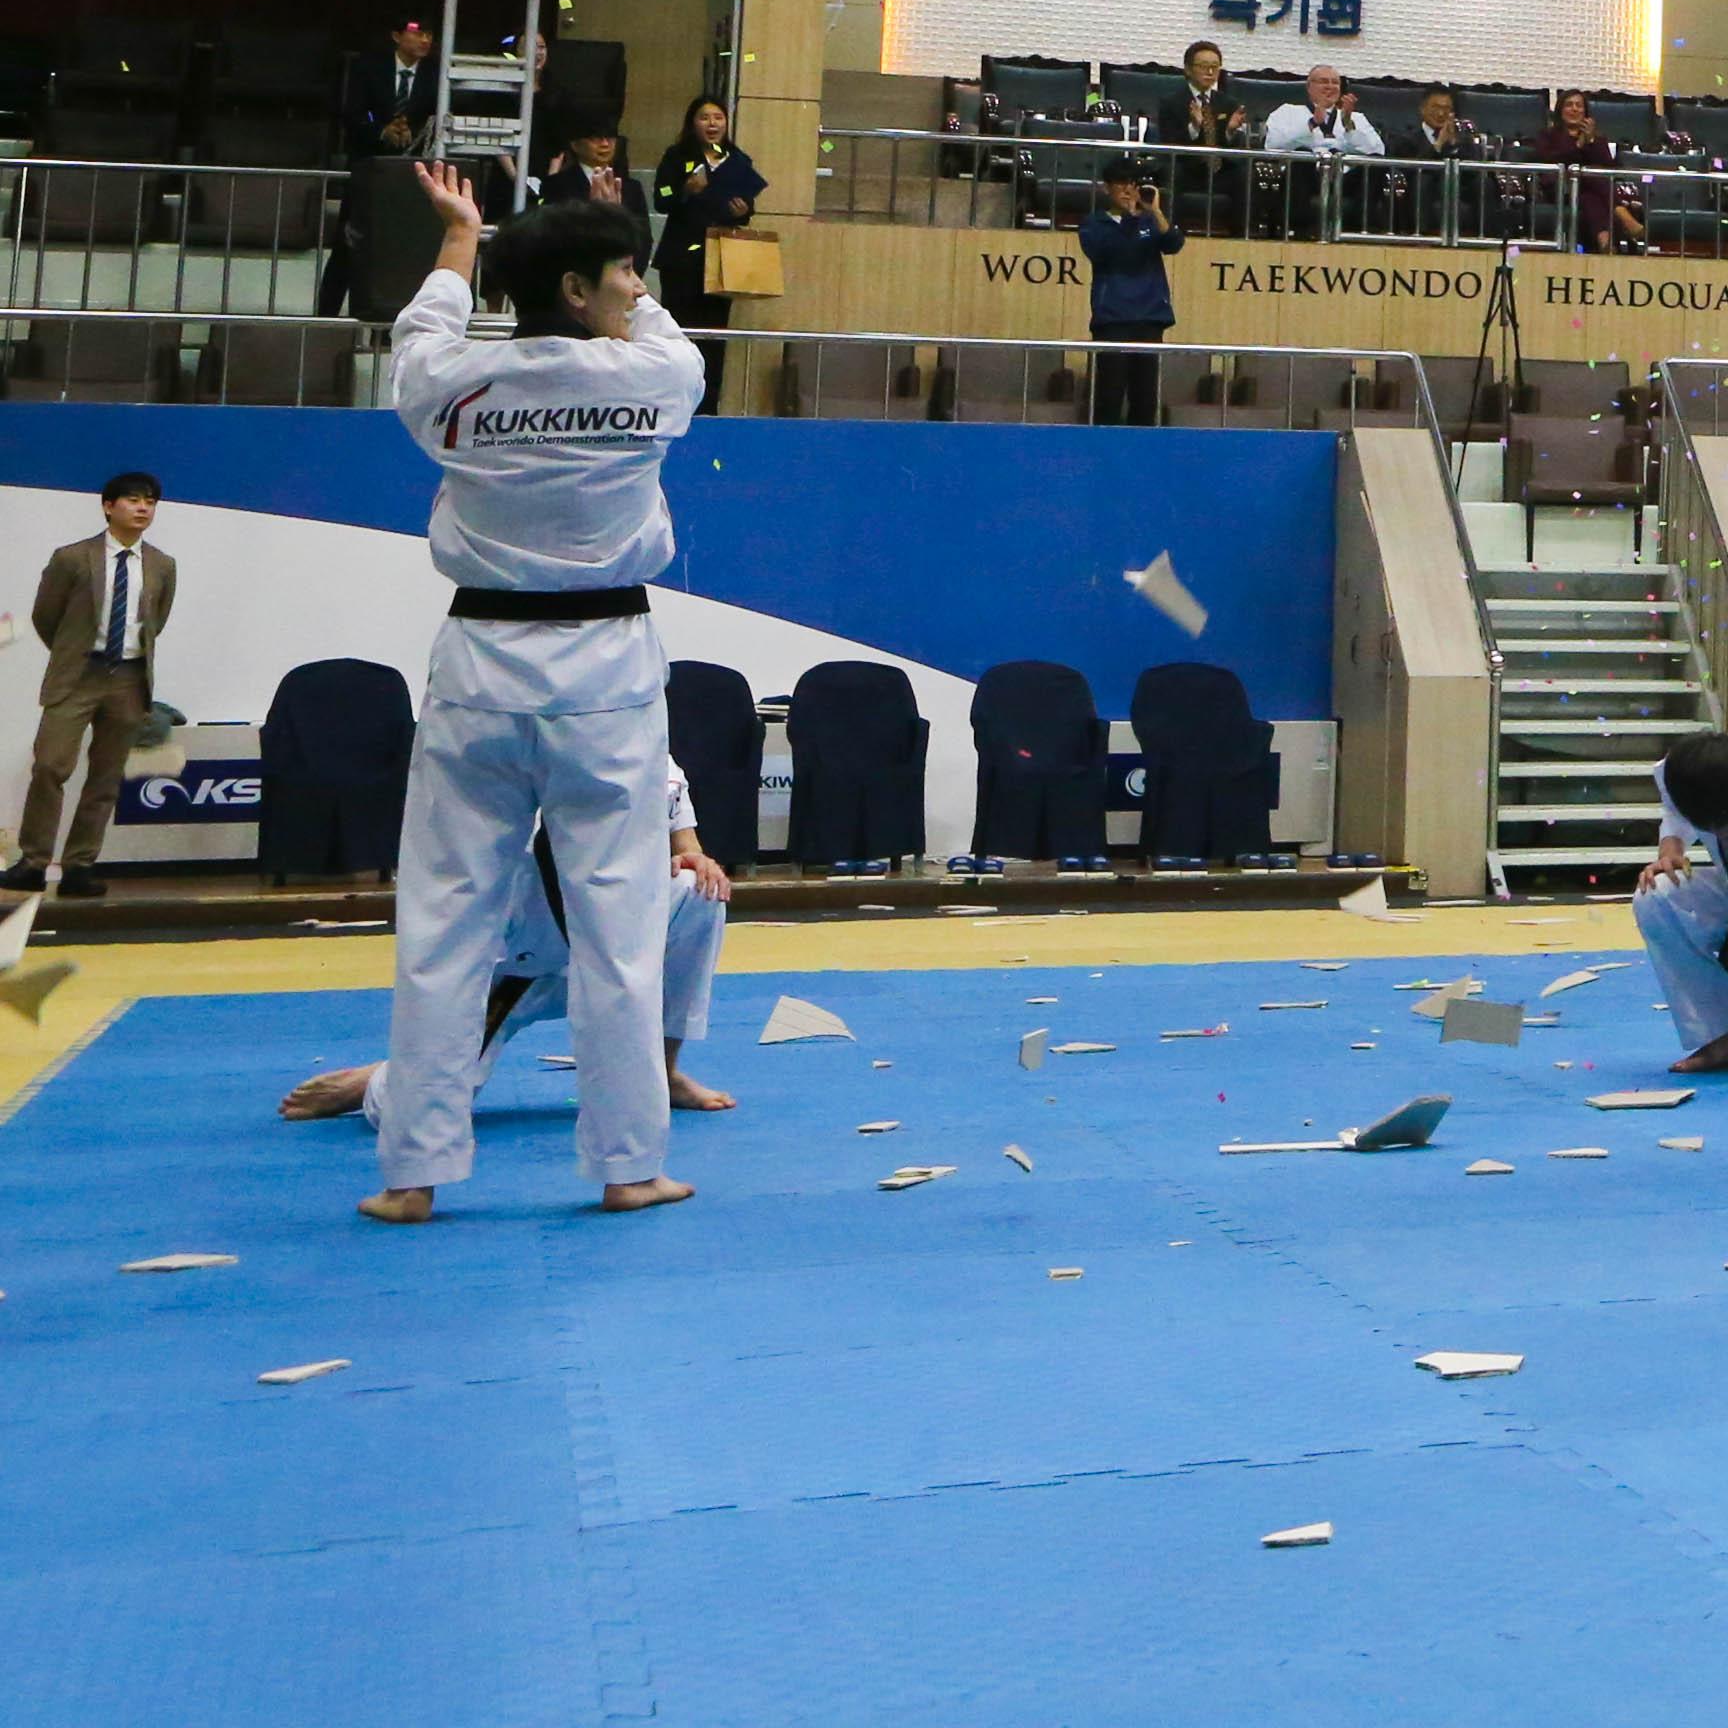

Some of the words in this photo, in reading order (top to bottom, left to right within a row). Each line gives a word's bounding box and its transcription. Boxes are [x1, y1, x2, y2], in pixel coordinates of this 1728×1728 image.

[1210, 262, 1482, 299] TAEKWONDO
[473, 406, 659, 436] KUKKIWON
[472, 435, 534, 449] Taekwondo
[537, 433, 625, 446] Demonstration
